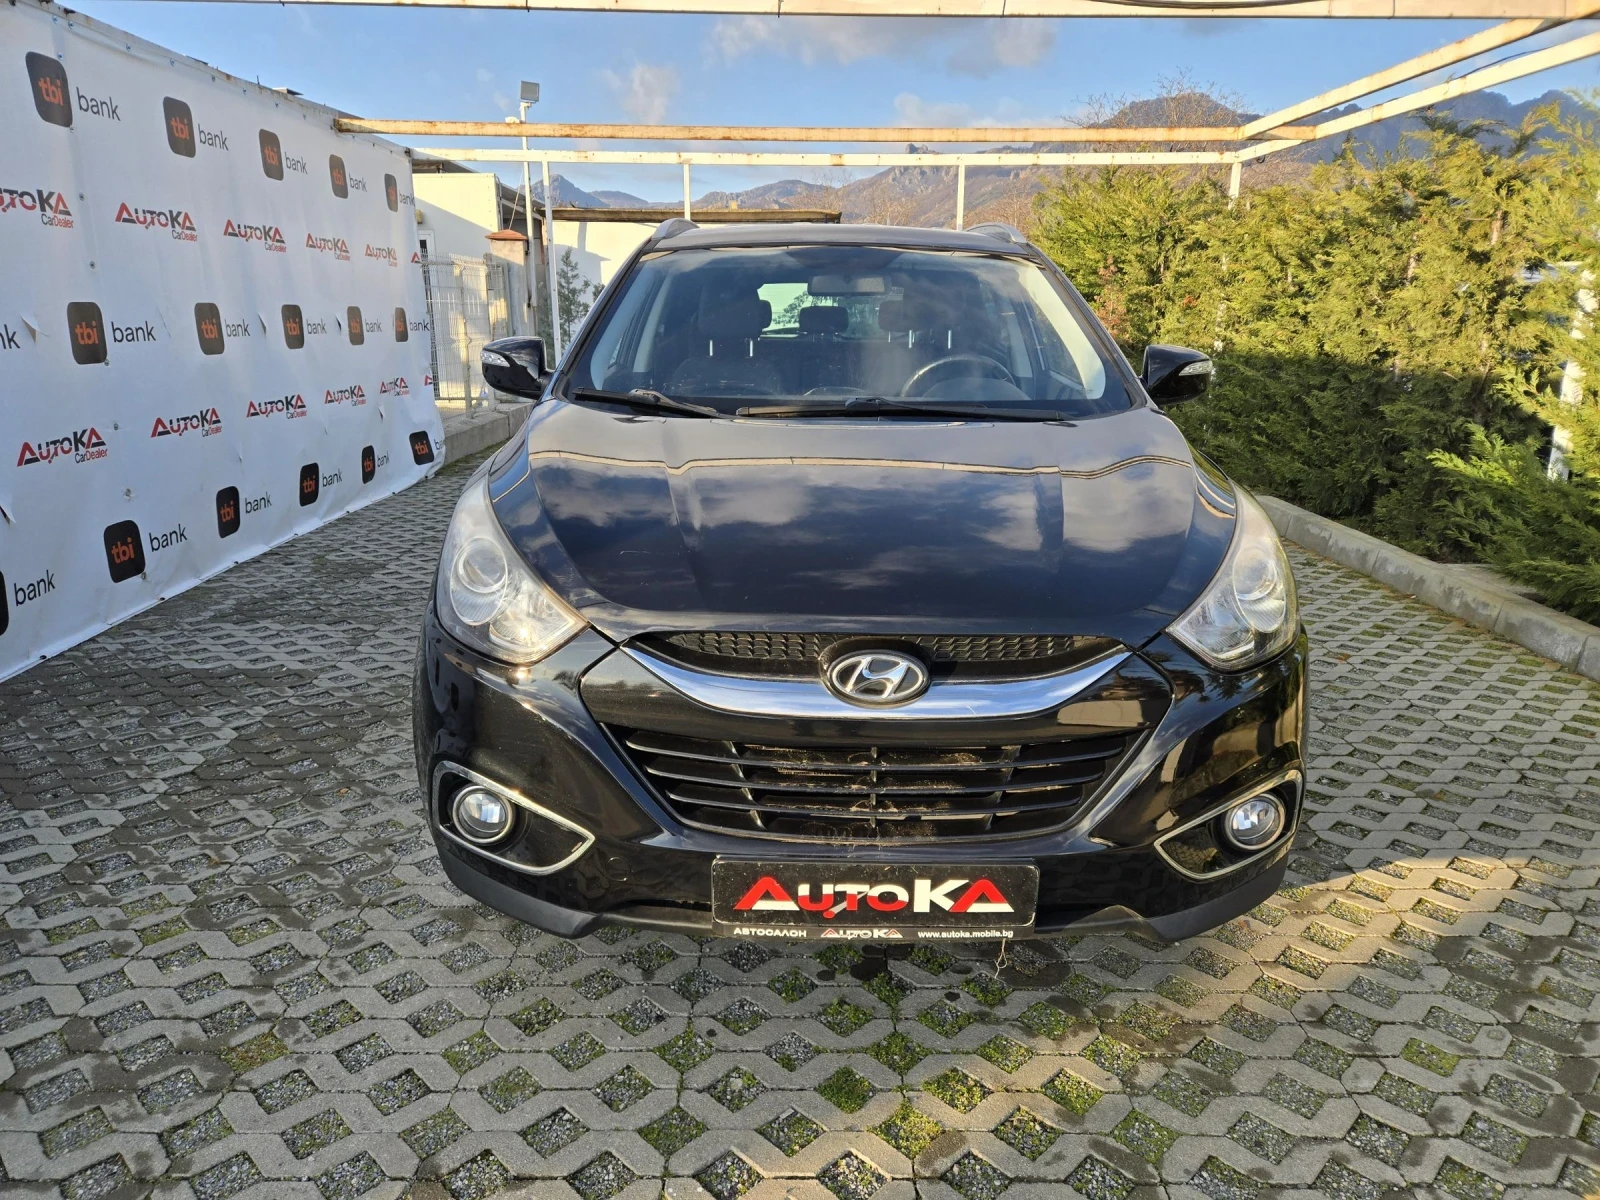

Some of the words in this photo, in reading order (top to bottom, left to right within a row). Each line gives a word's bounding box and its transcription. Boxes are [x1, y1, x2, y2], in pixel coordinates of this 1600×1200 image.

[38, 77, 64, 106] tbi
[76, 87, 121, 121] bank
[171, 117, 190, 140] tbi
[198, 124, 229, 151] bank
[264, 146, 279, 166] tbi
[285, 152, 308, 174] bank
[349, 173, 367, 192] bank
[75, 320, 99, 345] tbi
[111, 321, 156, 343] bank
[201, 318, 219, 340] tbi
[224, 319, 250, 338] bank
[286, 318, 300, 336] tbi
[306, 318, 327, 334] bank
[365, 318, 382, 333] bank
[409, 318, 430, 331] bank
[415, 440, 428, 456] tbi
[302, 476, 316, 494] tbi
[322, 468, 343, 488] bank
[220, 500, 234, 523] tbi
[245, 491, 272, 514] bank
[111, 537, 135, 564] tbi
[149, 523, 188, 552] bank
[13, 569, 56, 607] bank
[918, 929, 1014, 939] www.autoka.mobile.bg
